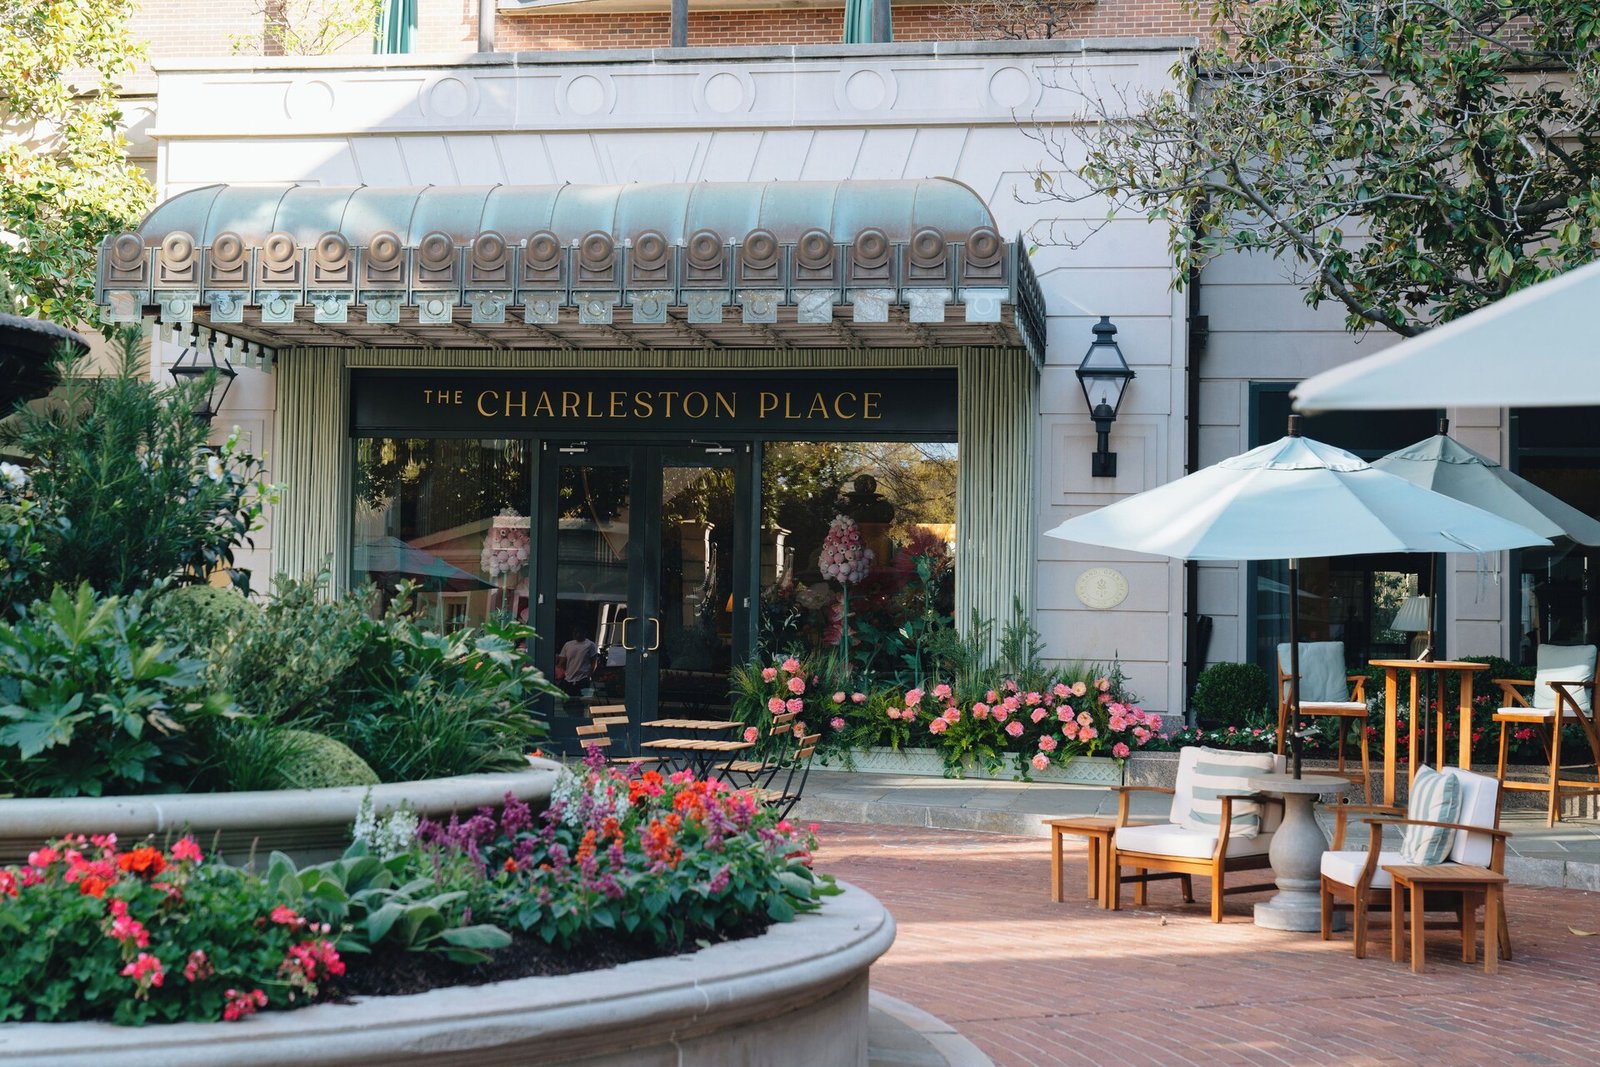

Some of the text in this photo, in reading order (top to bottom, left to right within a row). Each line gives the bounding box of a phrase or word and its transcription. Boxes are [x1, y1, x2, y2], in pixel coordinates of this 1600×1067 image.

[425, 390, 882, 419] THE CHARLESTON PLACE
